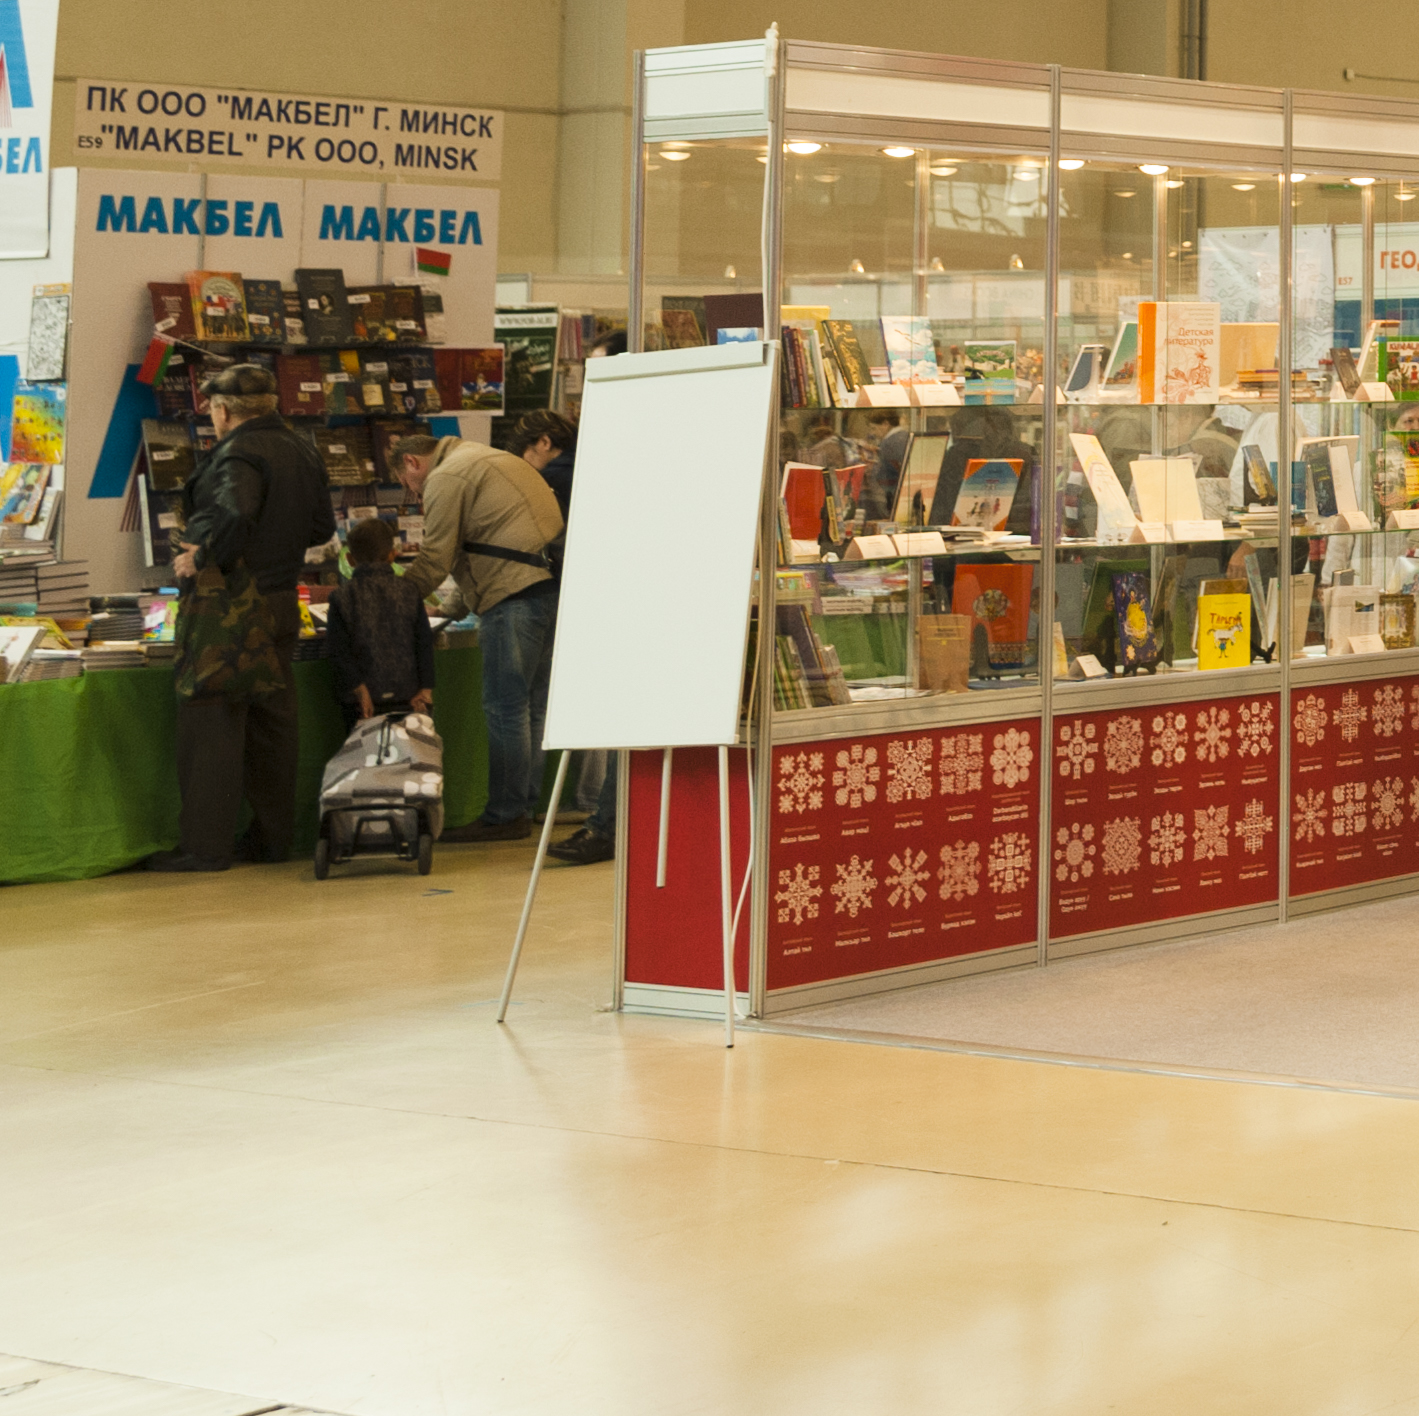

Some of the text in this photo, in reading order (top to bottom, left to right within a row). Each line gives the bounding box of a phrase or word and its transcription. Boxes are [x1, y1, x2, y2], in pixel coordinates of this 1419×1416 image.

[86, 86, 129, 114] ПК
[136, 89, 207, 118] ООО
[373, 107, 390, 132] Г.
[399, 111, 494, 140] МИНСК
[266, 135, 305, 161] PK
[393, 145, 478, 173] MINSK
[96, 194, 284, 240] МАКБЕЛ
[319, 204, 484, 246] МАКБЕЛ
[1164, 336, 1214, 347] литература
[1179, 327, 1214, 337] Детская
